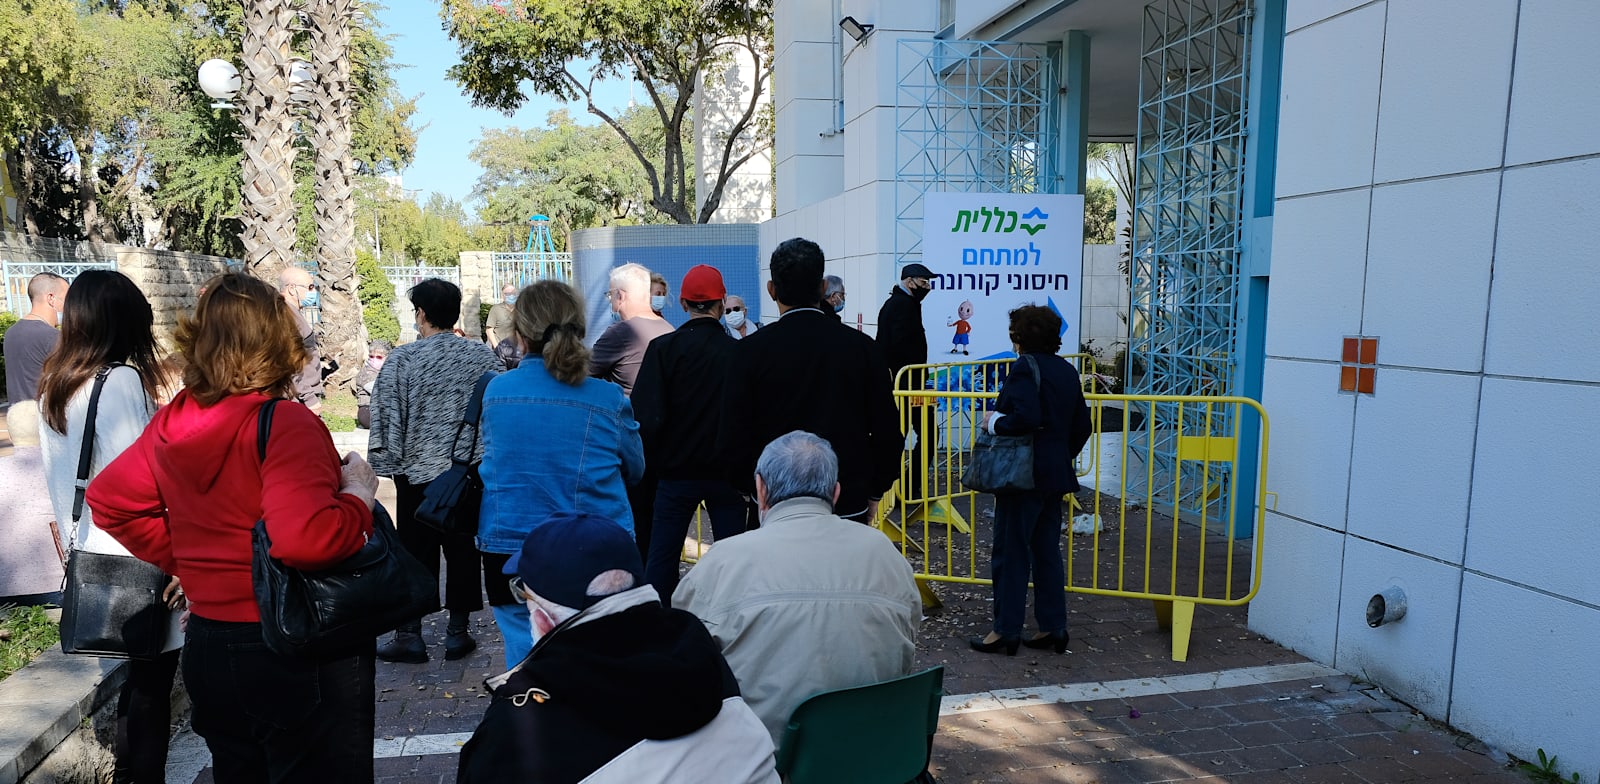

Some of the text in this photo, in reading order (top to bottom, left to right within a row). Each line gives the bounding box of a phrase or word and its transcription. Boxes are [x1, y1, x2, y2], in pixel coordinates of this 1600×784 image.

[951, 206, 1018, 233] כללית
[962, 241, 1041, 266] למתחם
[931, 273, 1069, 297] חיסוני קורונה
